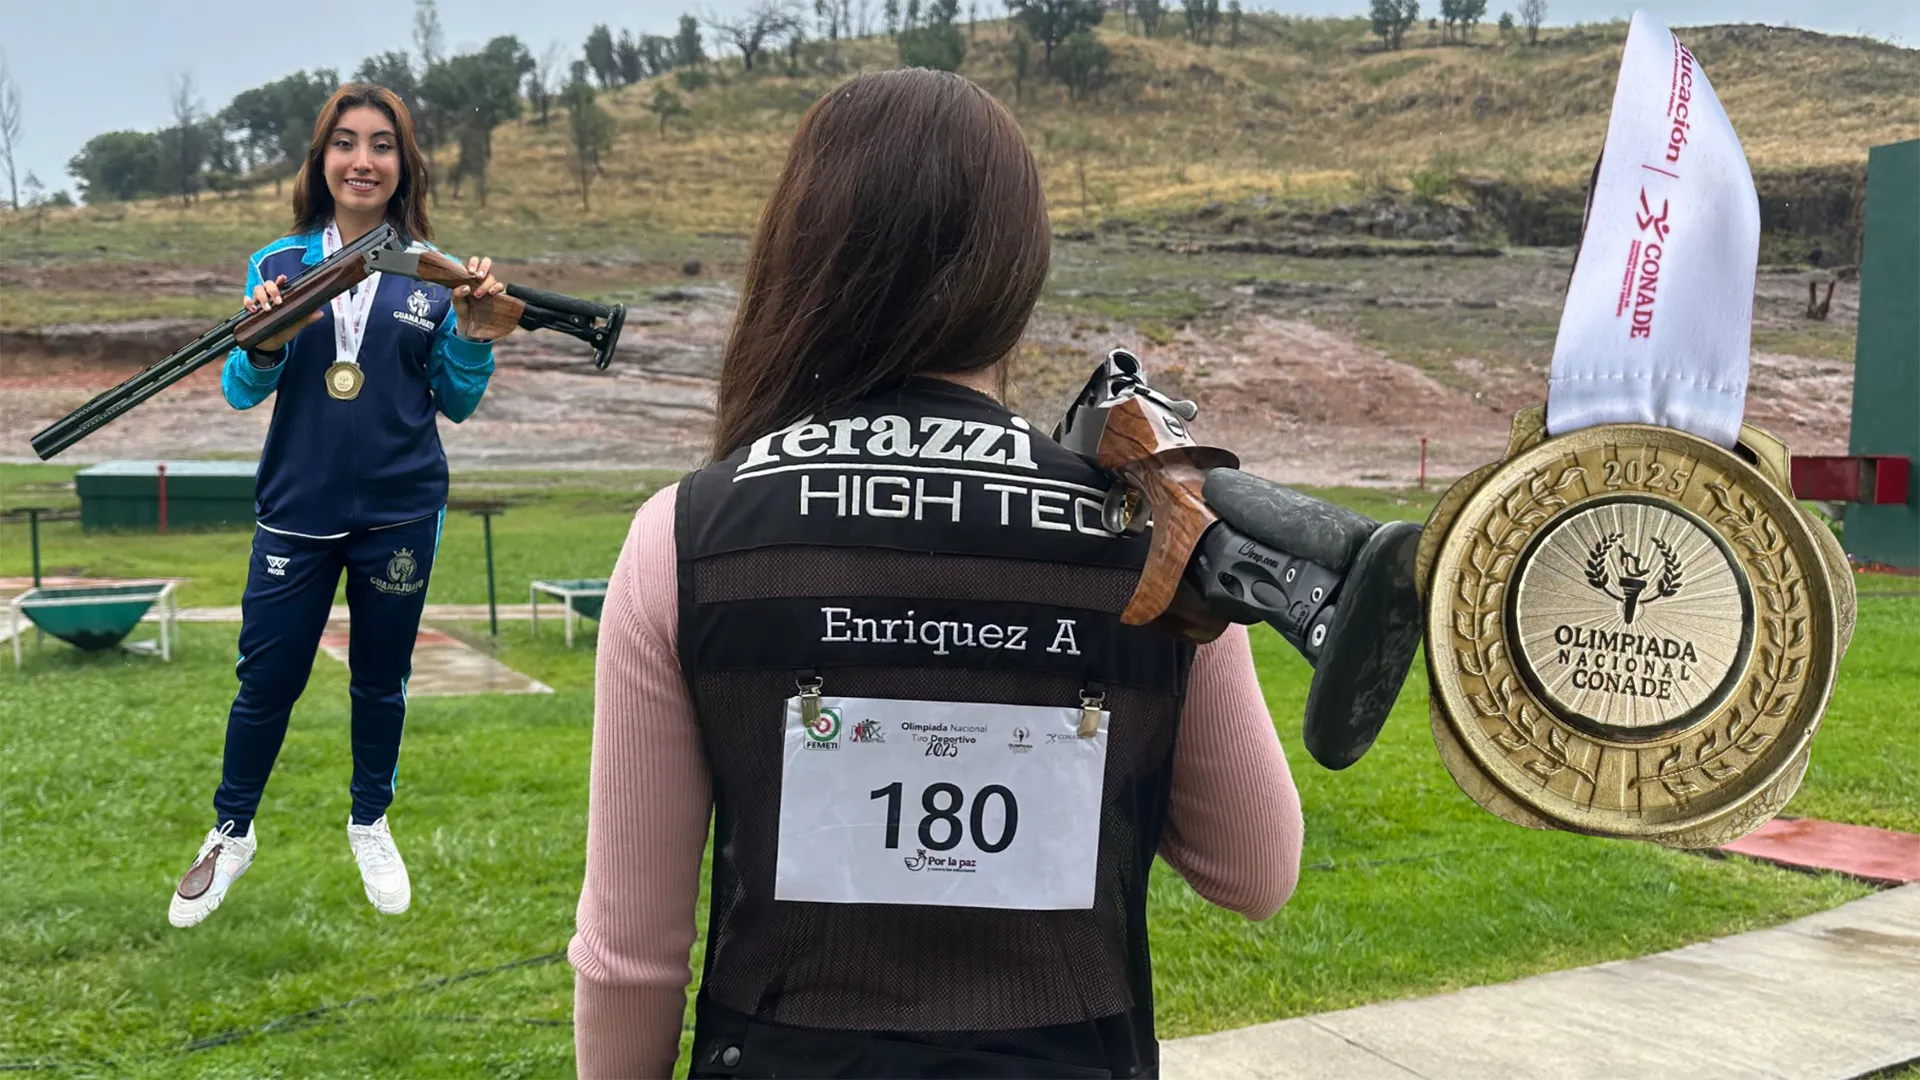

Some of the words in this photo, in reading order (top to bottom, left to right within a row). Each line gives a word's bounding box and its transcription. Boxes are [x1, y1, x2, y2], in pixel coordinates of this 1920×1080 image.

[1666, 41, 1695, 163] ducación
[1630, 243, 1662, 339] CONADE
[1603, 460, 1689, 493] 2025
[800, 475, 961, 523] HIGH
[984, 482, 1153, 539] TEC
[820, 607, 1029, 655] Enriquez
[1046, 619, 1081, 656] A
[1554, 624, 1698, 663] OLIMPIADA
[1558, 649, 1691, 681] NACIONAL
[1572, 669, 1672, 700] CONADE
[901, 722, 948, 732] Olimpiada
[950, 723, 988, 733] Nacional
[912, 734, 928, 742] Tiro
[931, 734, 977, 744] Deportivo
[806, 741, 838, 750] FEMETI
[925, 741, 958, 757] 2025
[870, 781, 1019, 854] 180
[928, 856, 946, 866] Por
[948, 857, 957, 866] la
[958, 860, 976, 868] paz
